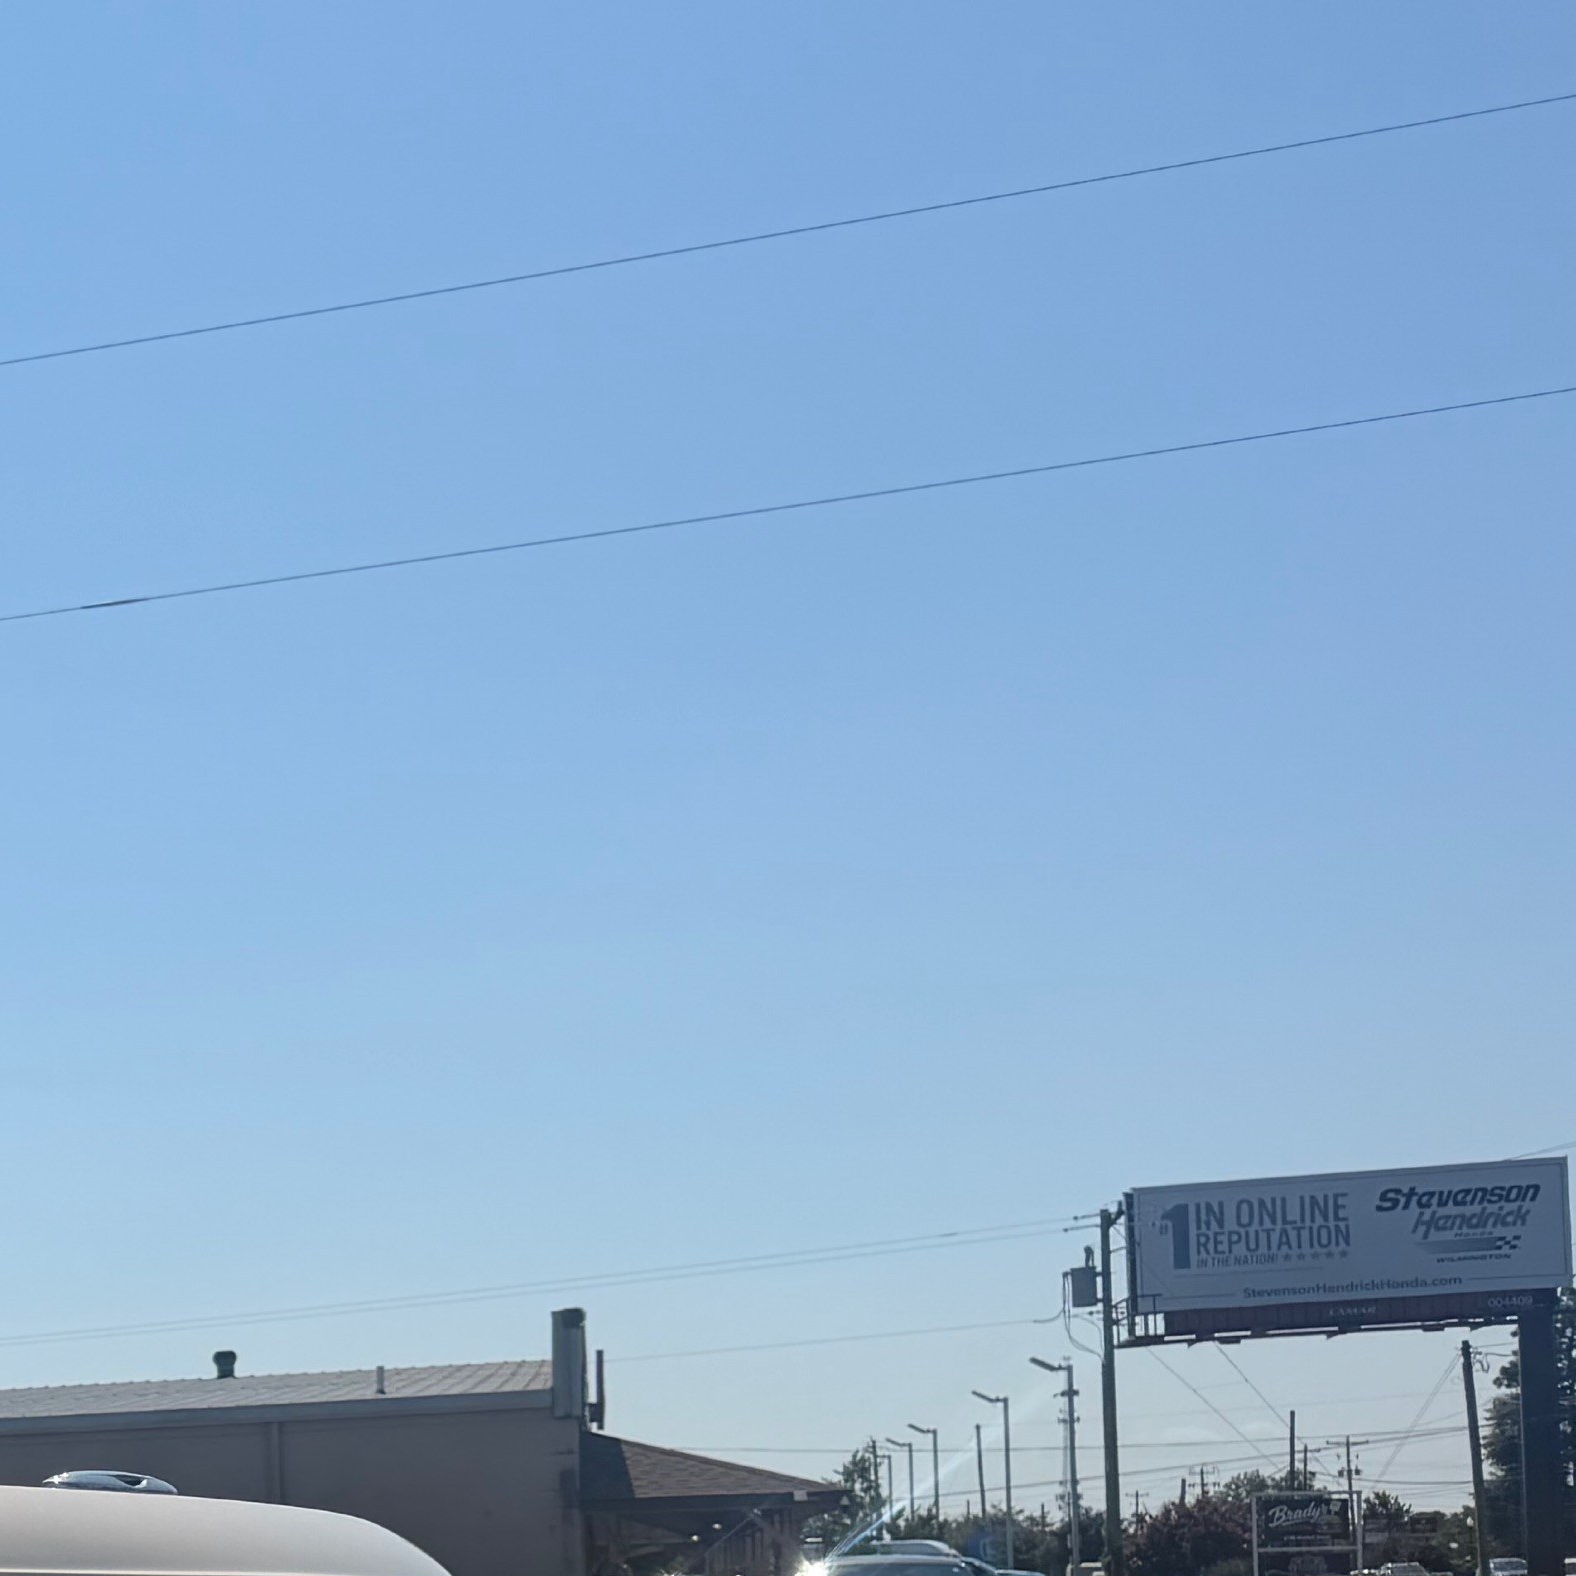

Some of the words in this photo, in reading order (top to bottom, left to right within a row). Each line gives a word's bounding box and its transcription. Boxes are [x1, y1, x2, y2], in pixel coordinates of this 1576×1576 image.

[1194, 1201, 1225, 1231] IN
[1235, 1192, 1350, 1229] ONLINE
[1375, 1183, 1541, 1213] Stevenson
[1411, 1204, 1531, 1240] Hendrick
[1195, 1223, 1351, 1256] REPUTATION
[1197, 1257, 1208, 1268] IN
[1211, 1255, 1230, 1267] THE
[1243, 1275, 1462, 1299] StevensonHendrickHonda.com
